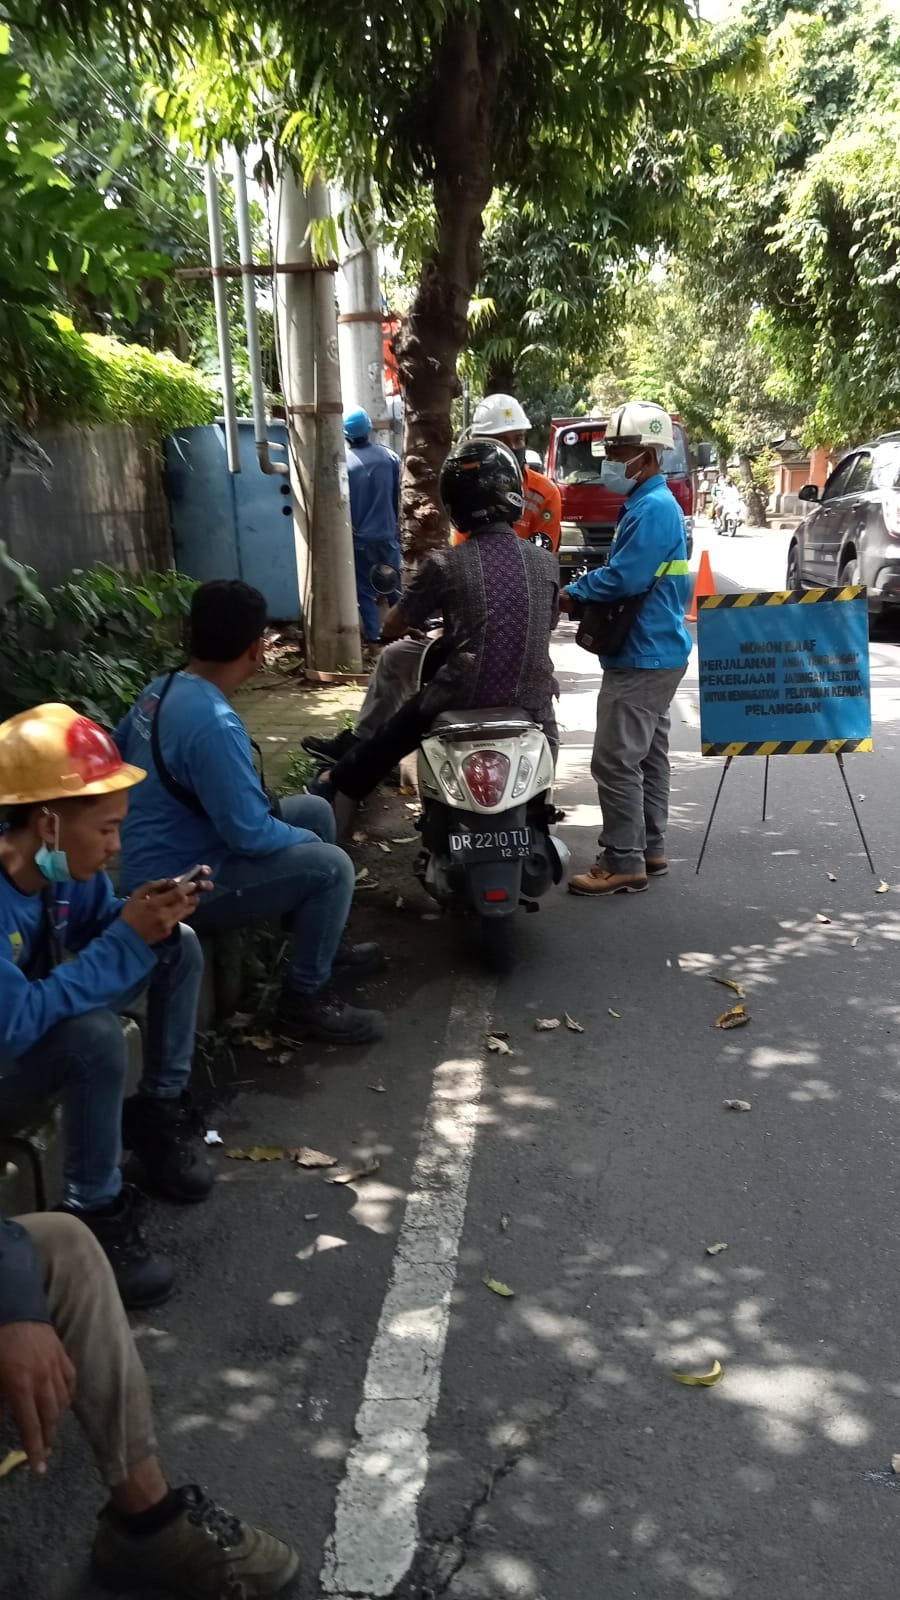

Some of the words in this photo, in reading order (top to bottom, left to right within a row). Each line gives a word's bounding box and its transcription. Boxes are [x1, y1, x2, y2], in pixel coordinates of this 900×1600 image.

[701, 657, 777, 672] PERJALANAN
[699, 672, 776, 687] PEKERJAAN
[745, 702, 822, 717] PELANGGAN
[451, 835, 472, 850] DR
[475, 832, 508, 848] 2210
[510, 830, 530, 846] TU
[501, 848, 513, 857] 12
